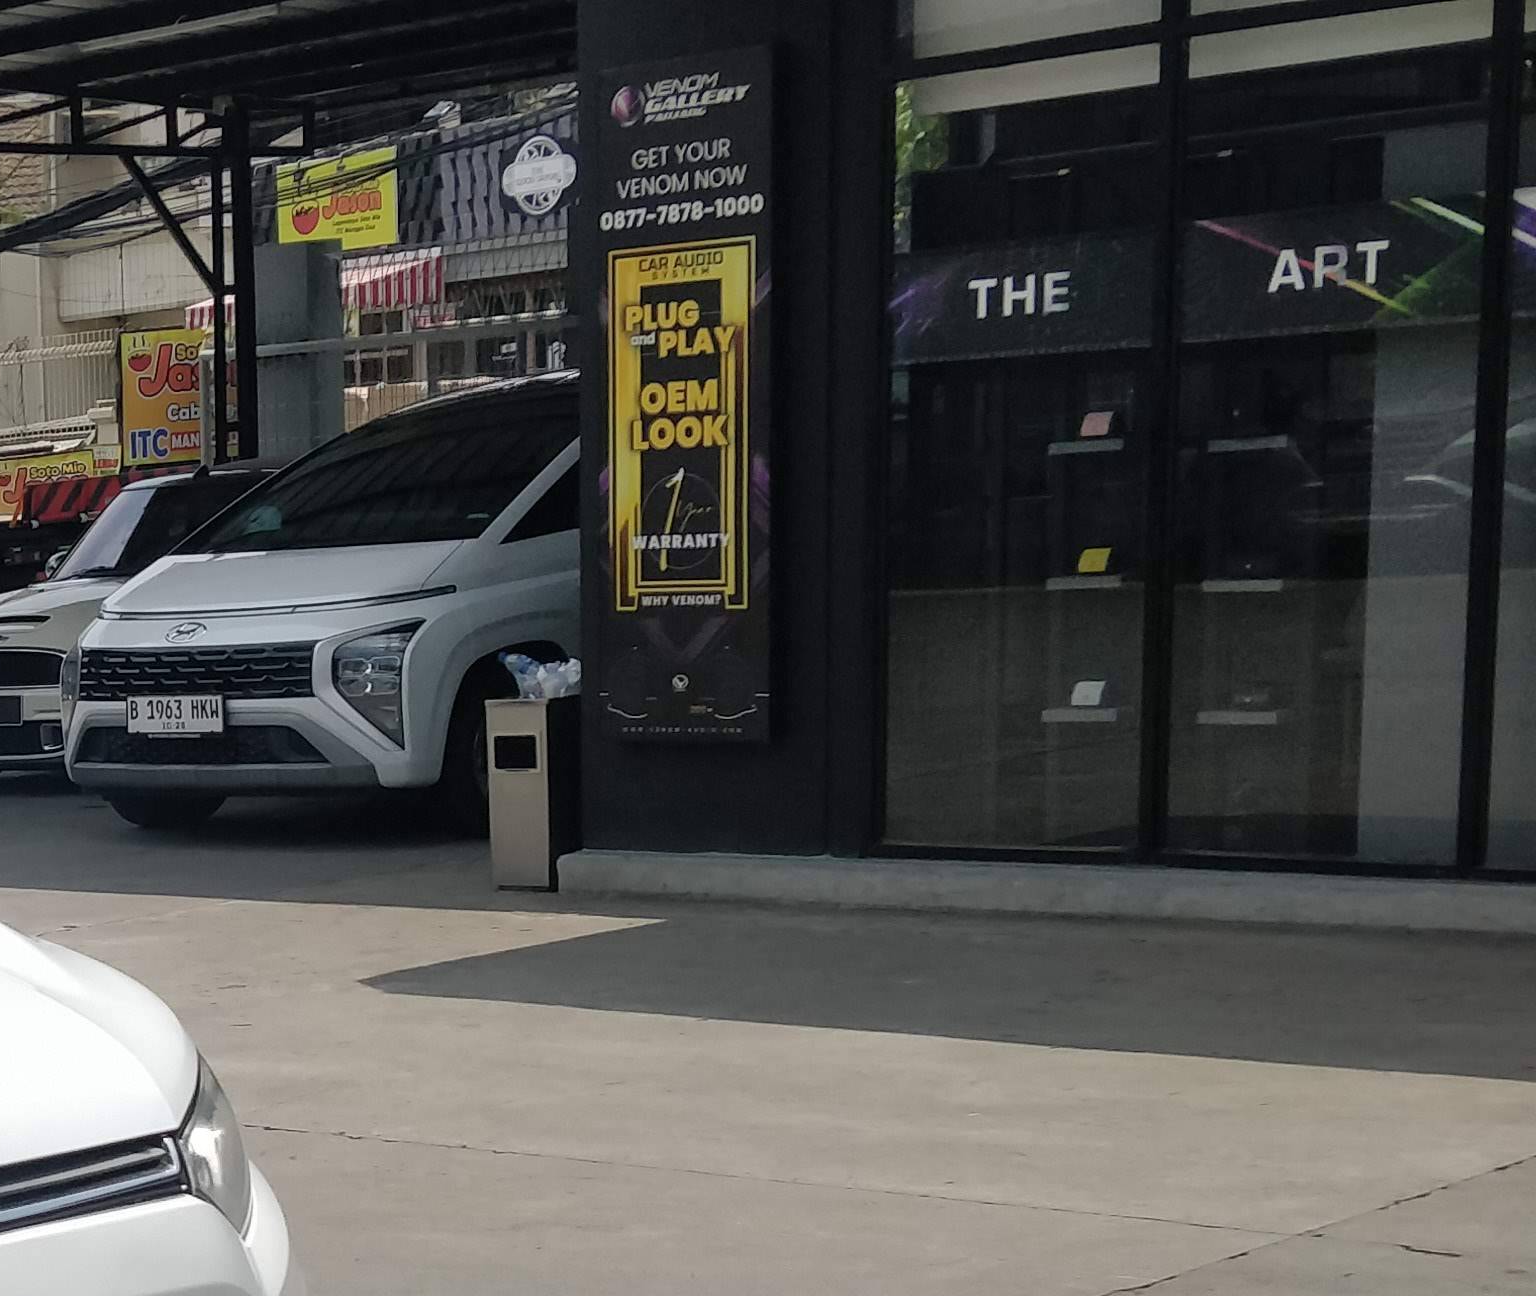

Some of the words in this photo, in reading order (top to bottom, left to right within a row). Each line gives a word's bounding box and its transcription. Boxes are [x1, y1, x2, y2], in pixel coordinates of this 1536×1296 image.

[644, 84, 751, 114] GALLERY
[645, 72, 719, 98] VENOM
[631, 145, 669, 170] GET
[674, 138, 731, 164] YOUR
[616, 171, 688, 199] VENOM
[694, 164, 747, 190] NOW
[322, 189, 382, 220] Jason
[600, 193, 765, 231] 0877-7878-1000
[639, 256, 669, 273] CAR
[674, 250, 723, 268] AUDIO
[652, 267, 711, 280] SYSTEM
[968, 270, 1071, 320] THE
[1267, 239, 1390, 293] ART
[625, 299, 700, 332] PLUG
[631, 332, 656, 346] and
[659, 326, 736, 358] PLAY
[640, 378, 718, 415] OEM
[130, 427, 168, 460] ITC
[632, 414, 729, 450] LOOK
[29, 464, 60, 479] Soto
[632, 532, 730, 551] WARRANTY
[641, 594, 670, 607] WHY
[671, 593, 722, 607] VENOM?
[129, 700, 139, 720] B
[146, 699, 183, 720] 1963
[190, 698, 220, 720] HKW
